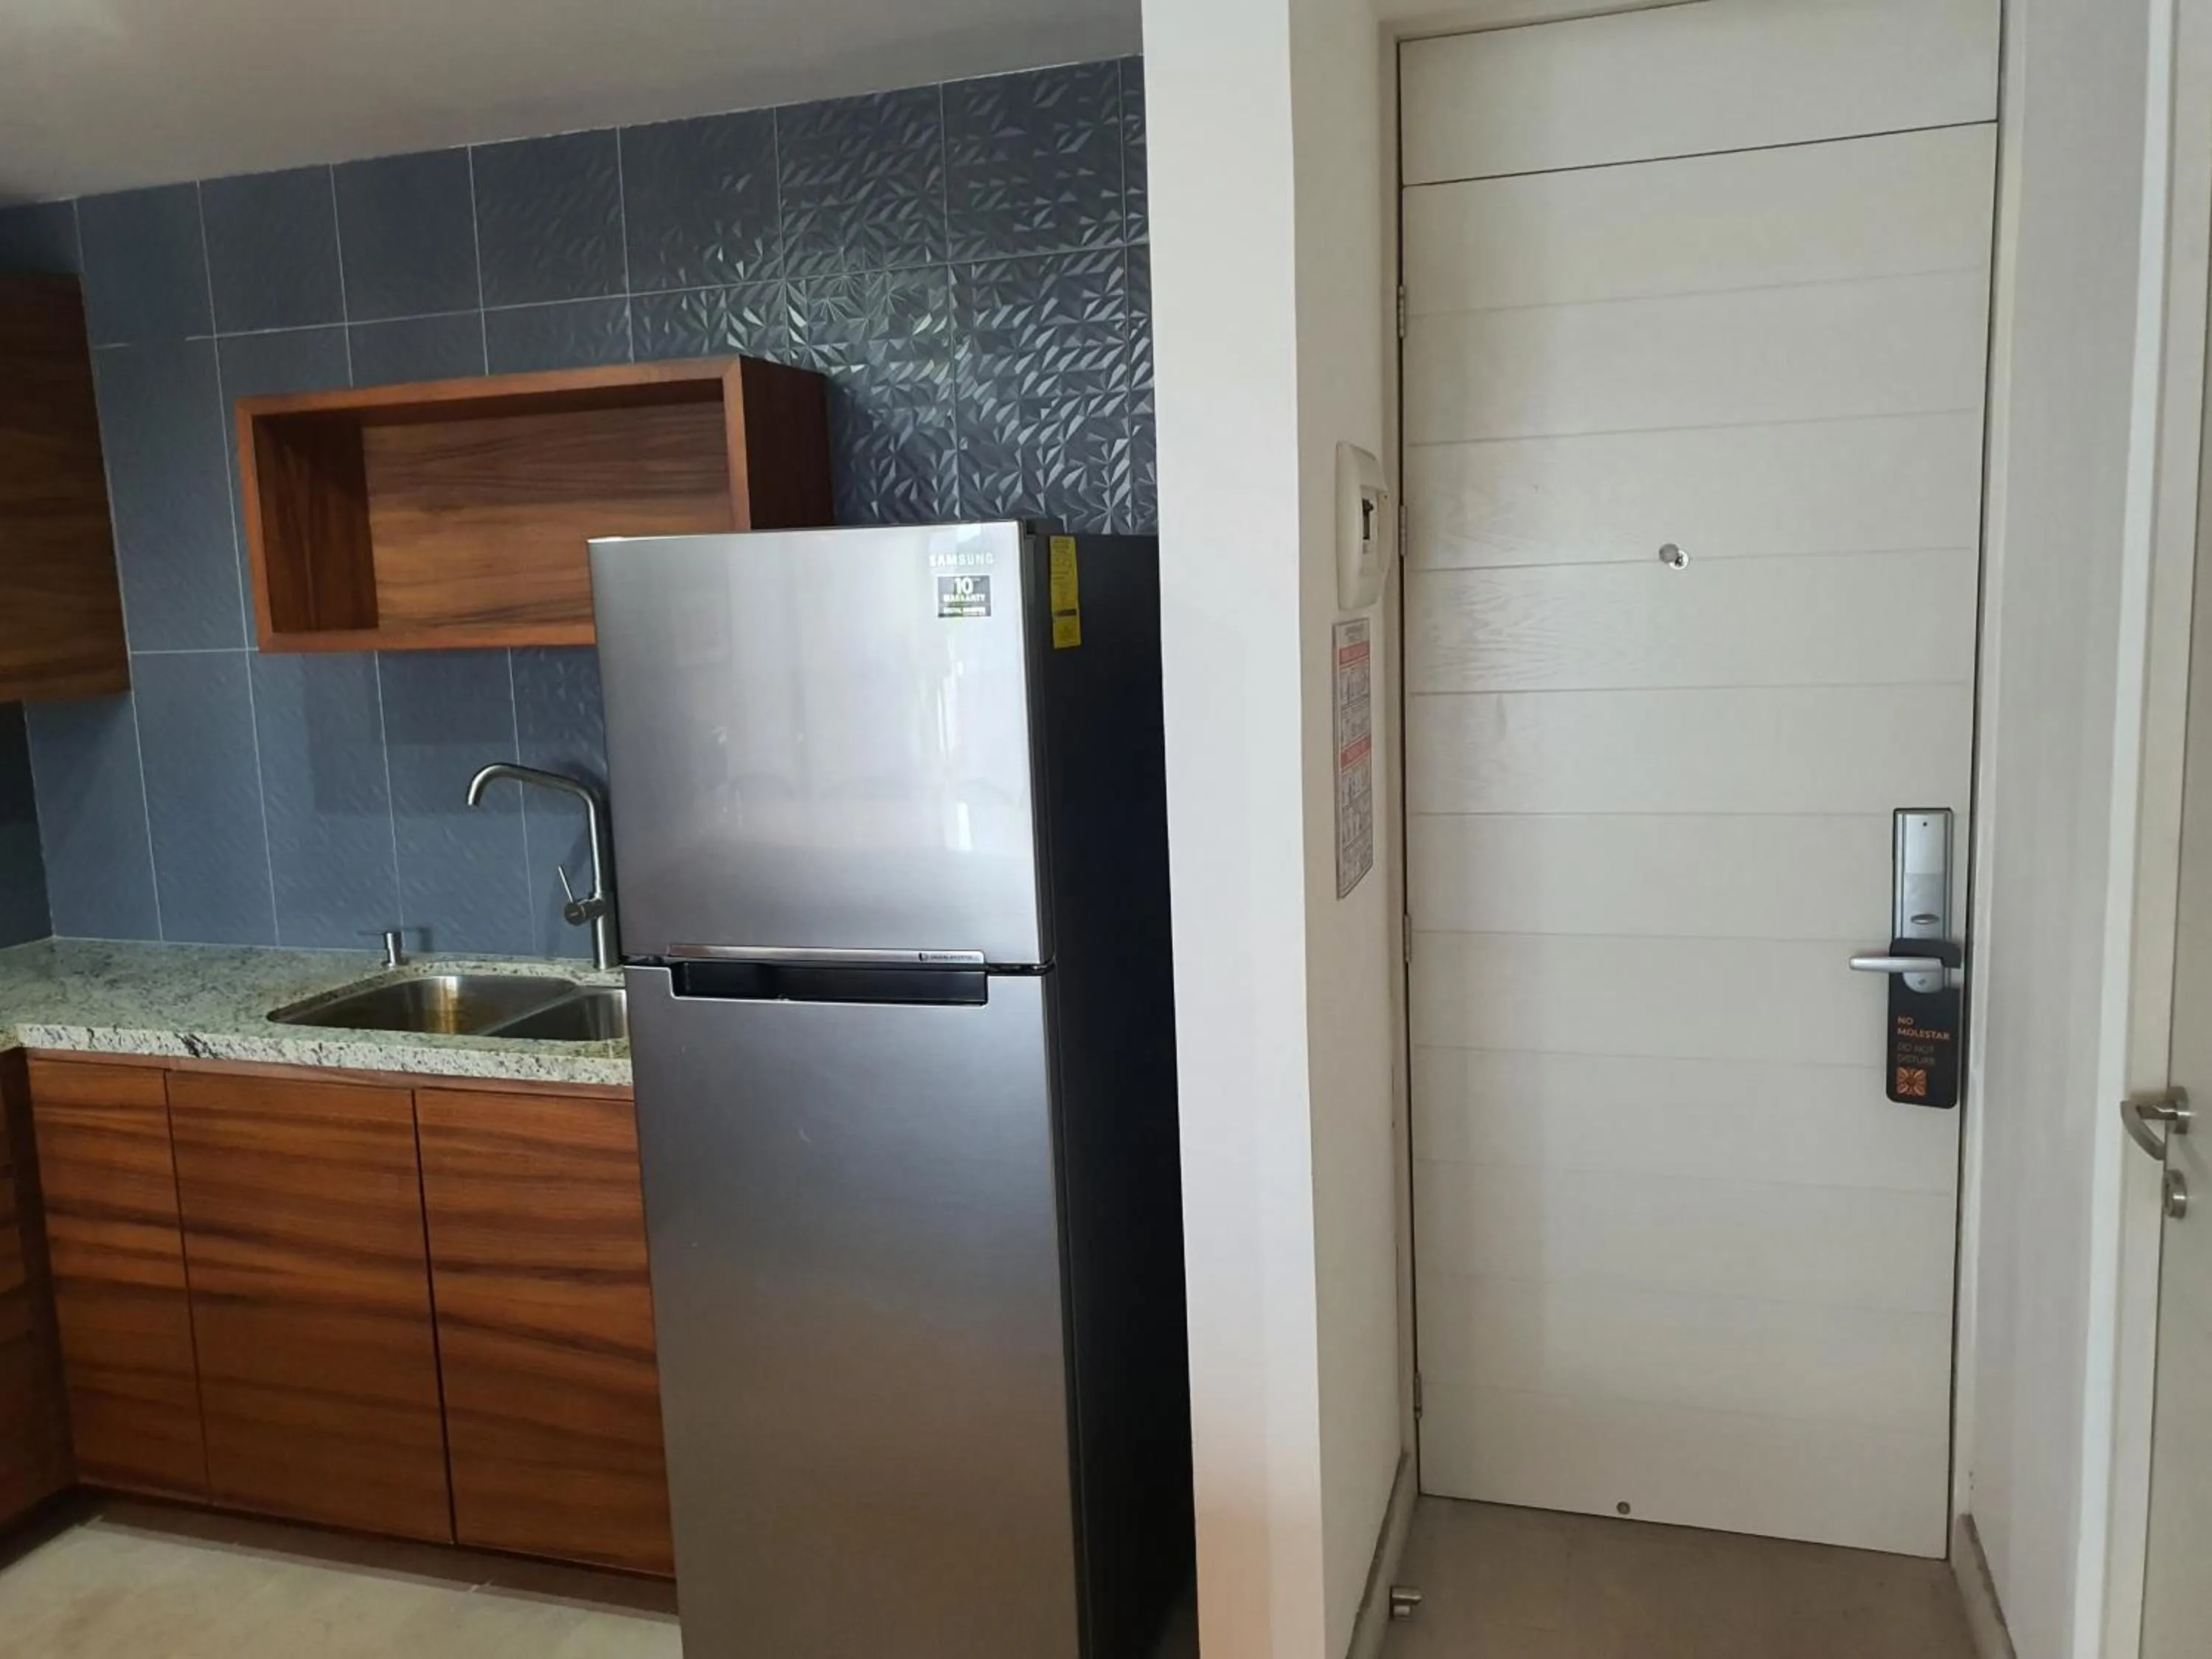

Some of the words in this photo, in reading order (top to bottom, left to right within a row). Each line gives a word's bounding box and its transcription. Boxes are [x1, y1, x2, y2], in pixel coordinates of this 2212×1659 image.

[929, 553, 993, 567] SAMSUNG
[954, 577, 973, 594] 10
[1897, 1016, 1913, 1025] NO
[1897, 1028, 1950, 1040] MOLESTAR
[1897, 1042, 1913, 1052] DO
[1914, 1044, 1935, 1054] NOT
